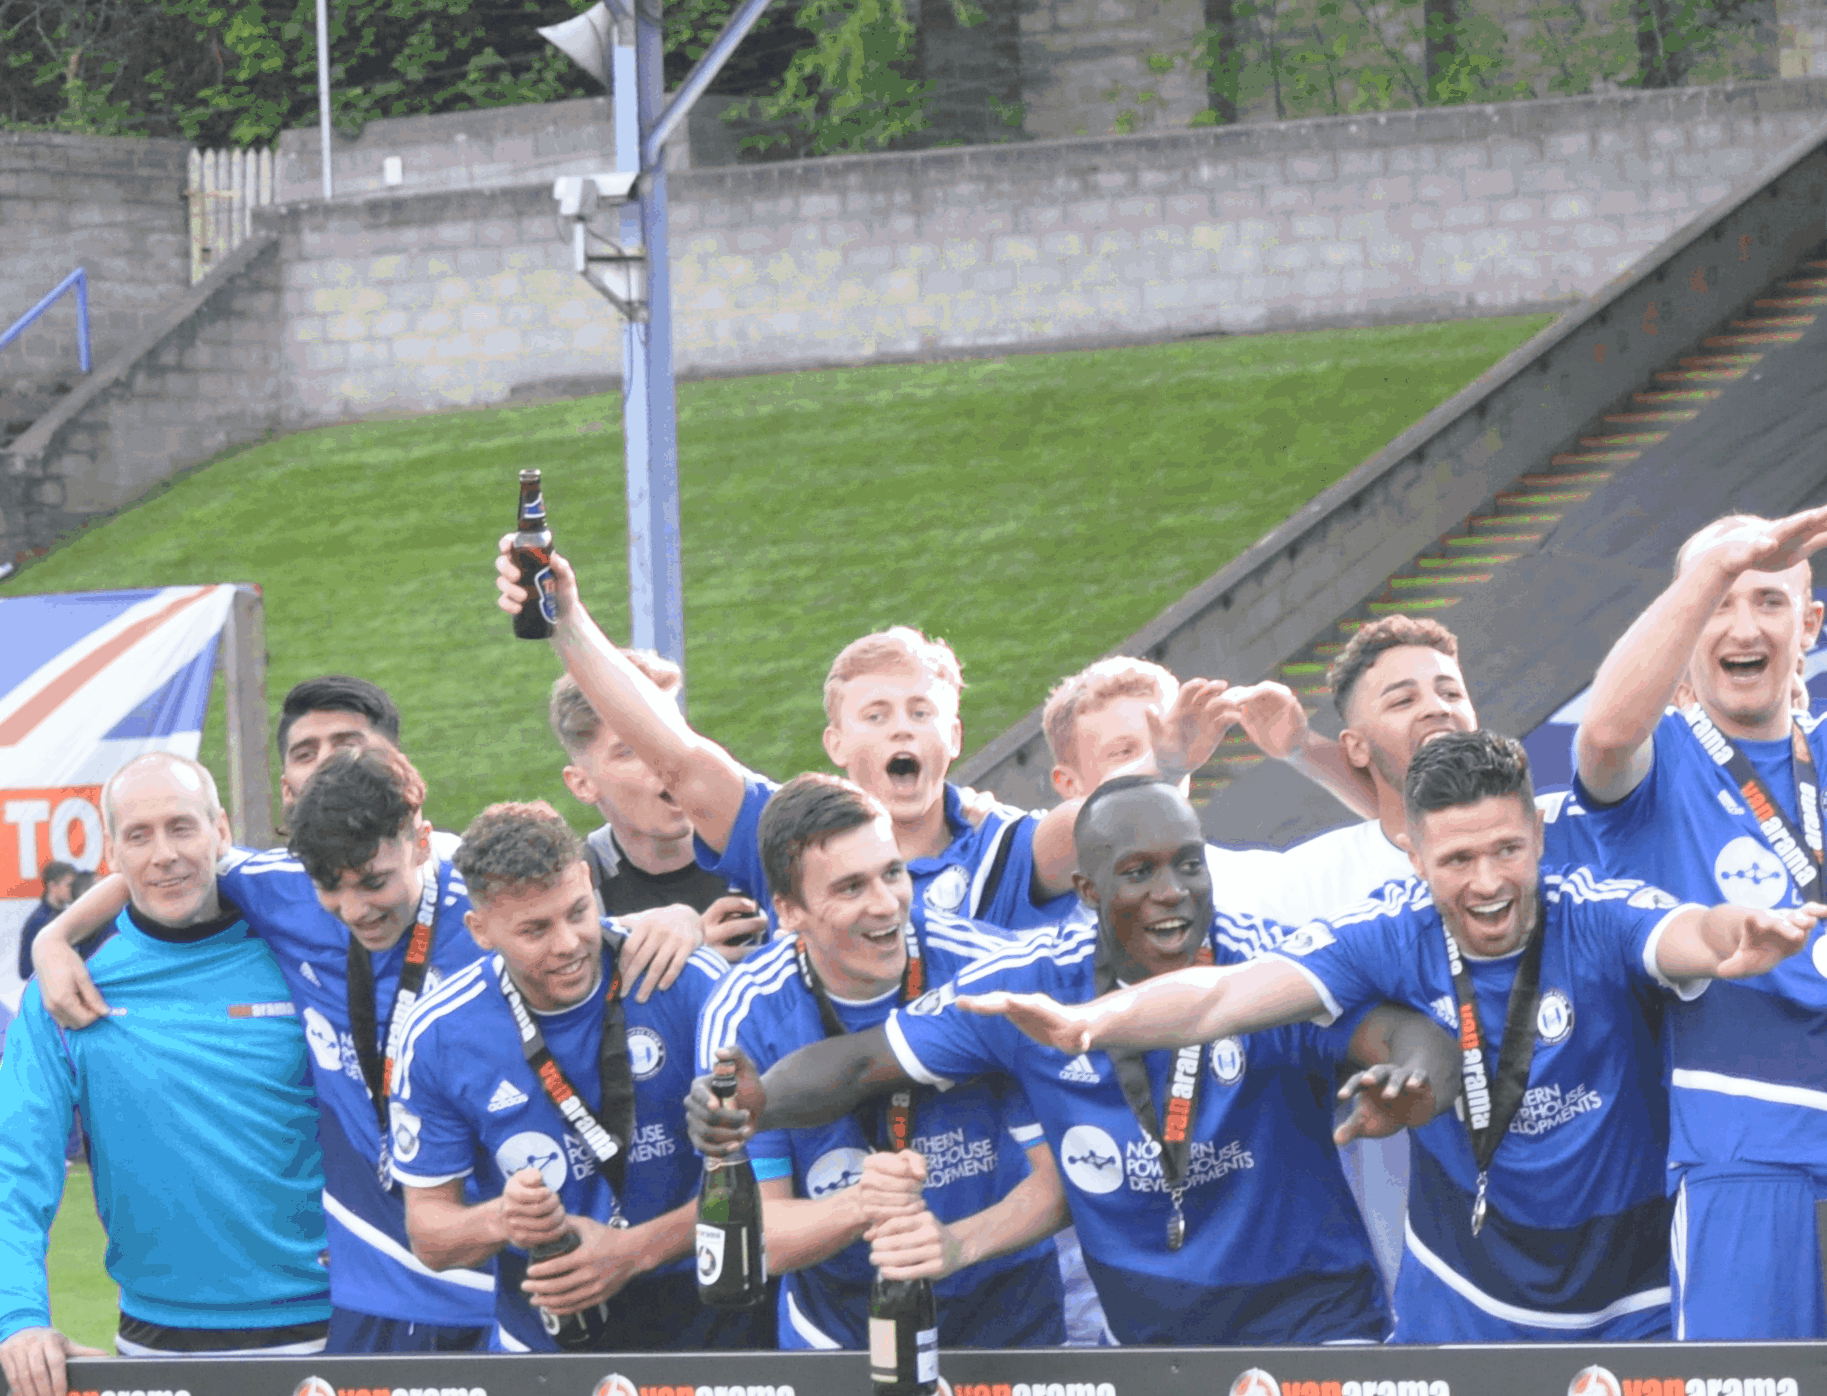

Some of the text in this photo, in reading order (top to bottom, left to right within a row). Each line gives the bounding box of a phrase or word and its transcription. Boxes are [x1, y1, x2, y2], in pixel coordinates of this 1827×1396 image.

[1741, 779, 1817, 888] vanarama
[539, 1060, 618, 1162] vanarama
[1164, 1044, 1202, 1143] vanara
[1458, 1002, 1492, 1131] vanarama
